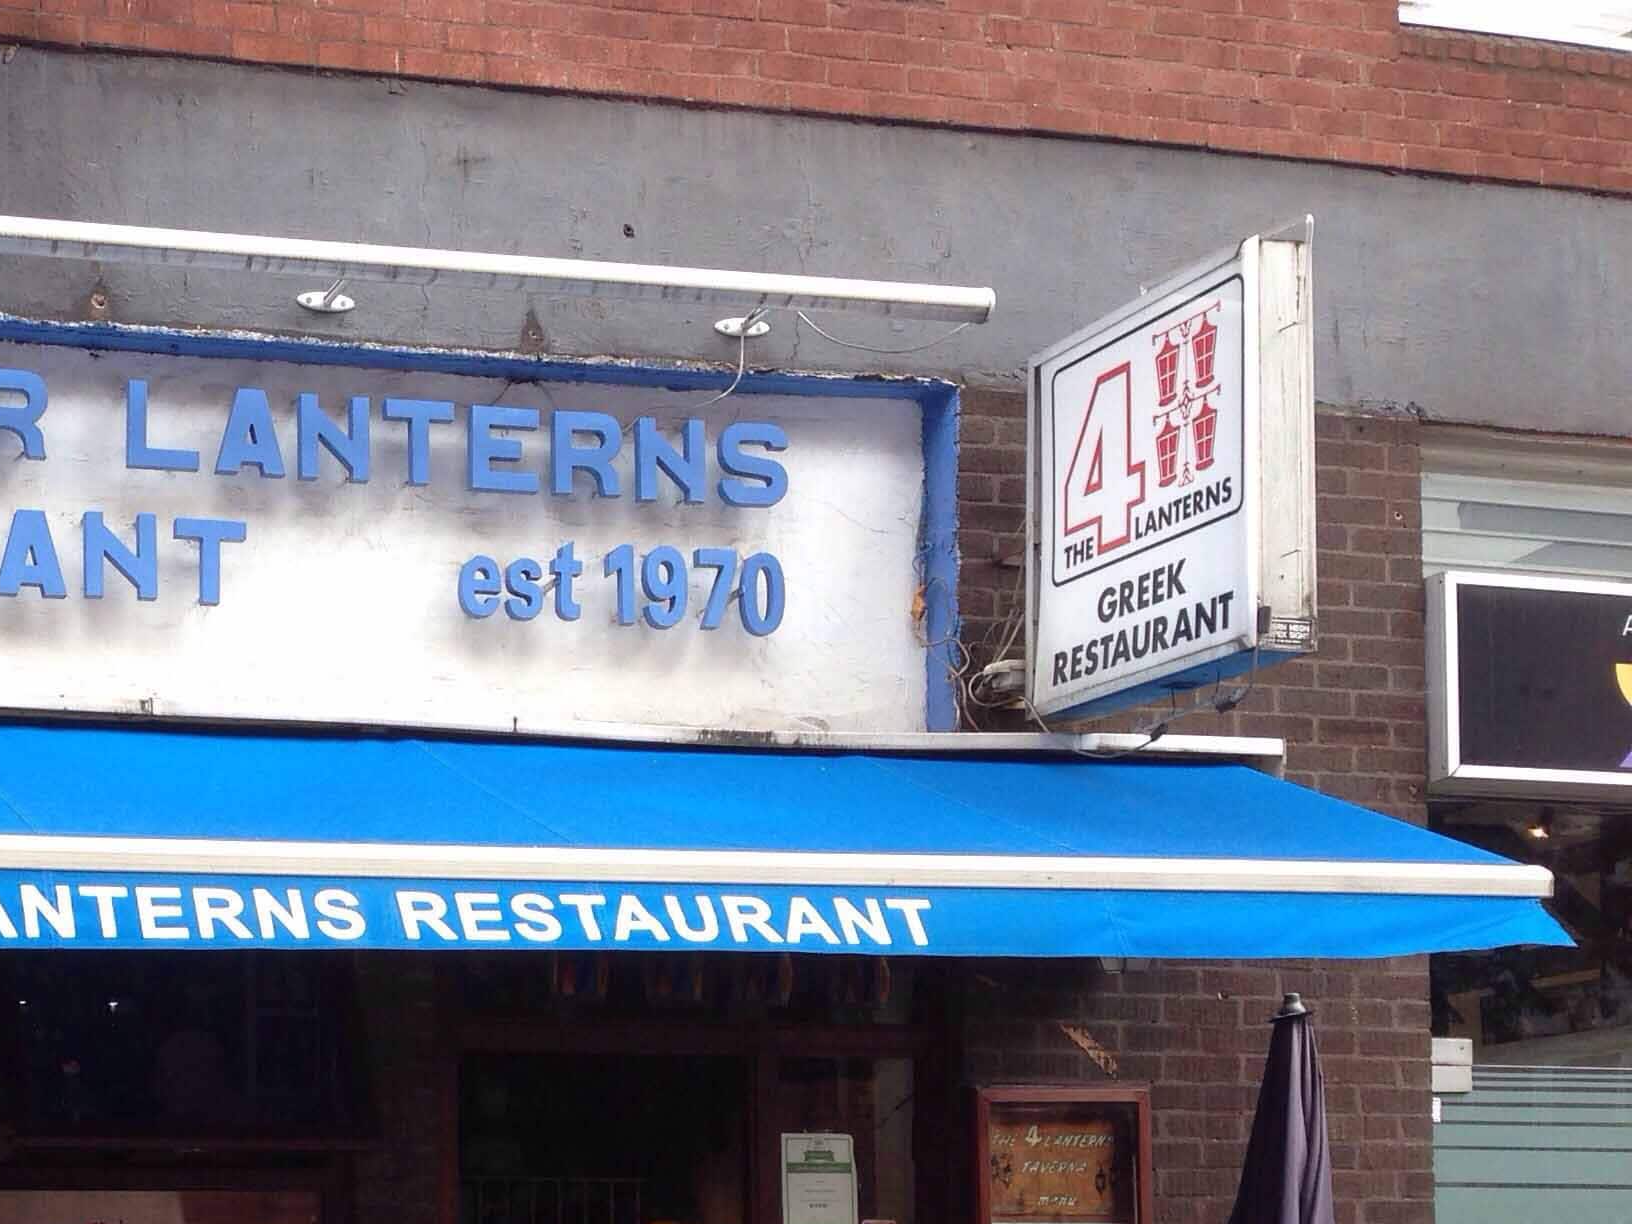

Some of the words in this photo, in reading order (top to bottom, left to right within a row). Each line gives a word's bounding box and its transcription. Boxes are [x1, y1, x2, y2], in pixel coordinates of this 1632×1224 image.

[125, 378, 790, 508] LANTERNS
[1064, 360, 1146, 556] 4
[1134, 477, 1233, 541] LANTERNS
[1063, 536, 1094, 570] THE
[458, 541, 583, 622] est
[603, 543, 786, 637] 1970
[1097, 558, 1187, 624] GREEK
[1052, 591, 1235, 688] RESTAURANT
[394, 888, 932, 946] RESTAURANT
[1024, 1124, 1043, 1148] 4
